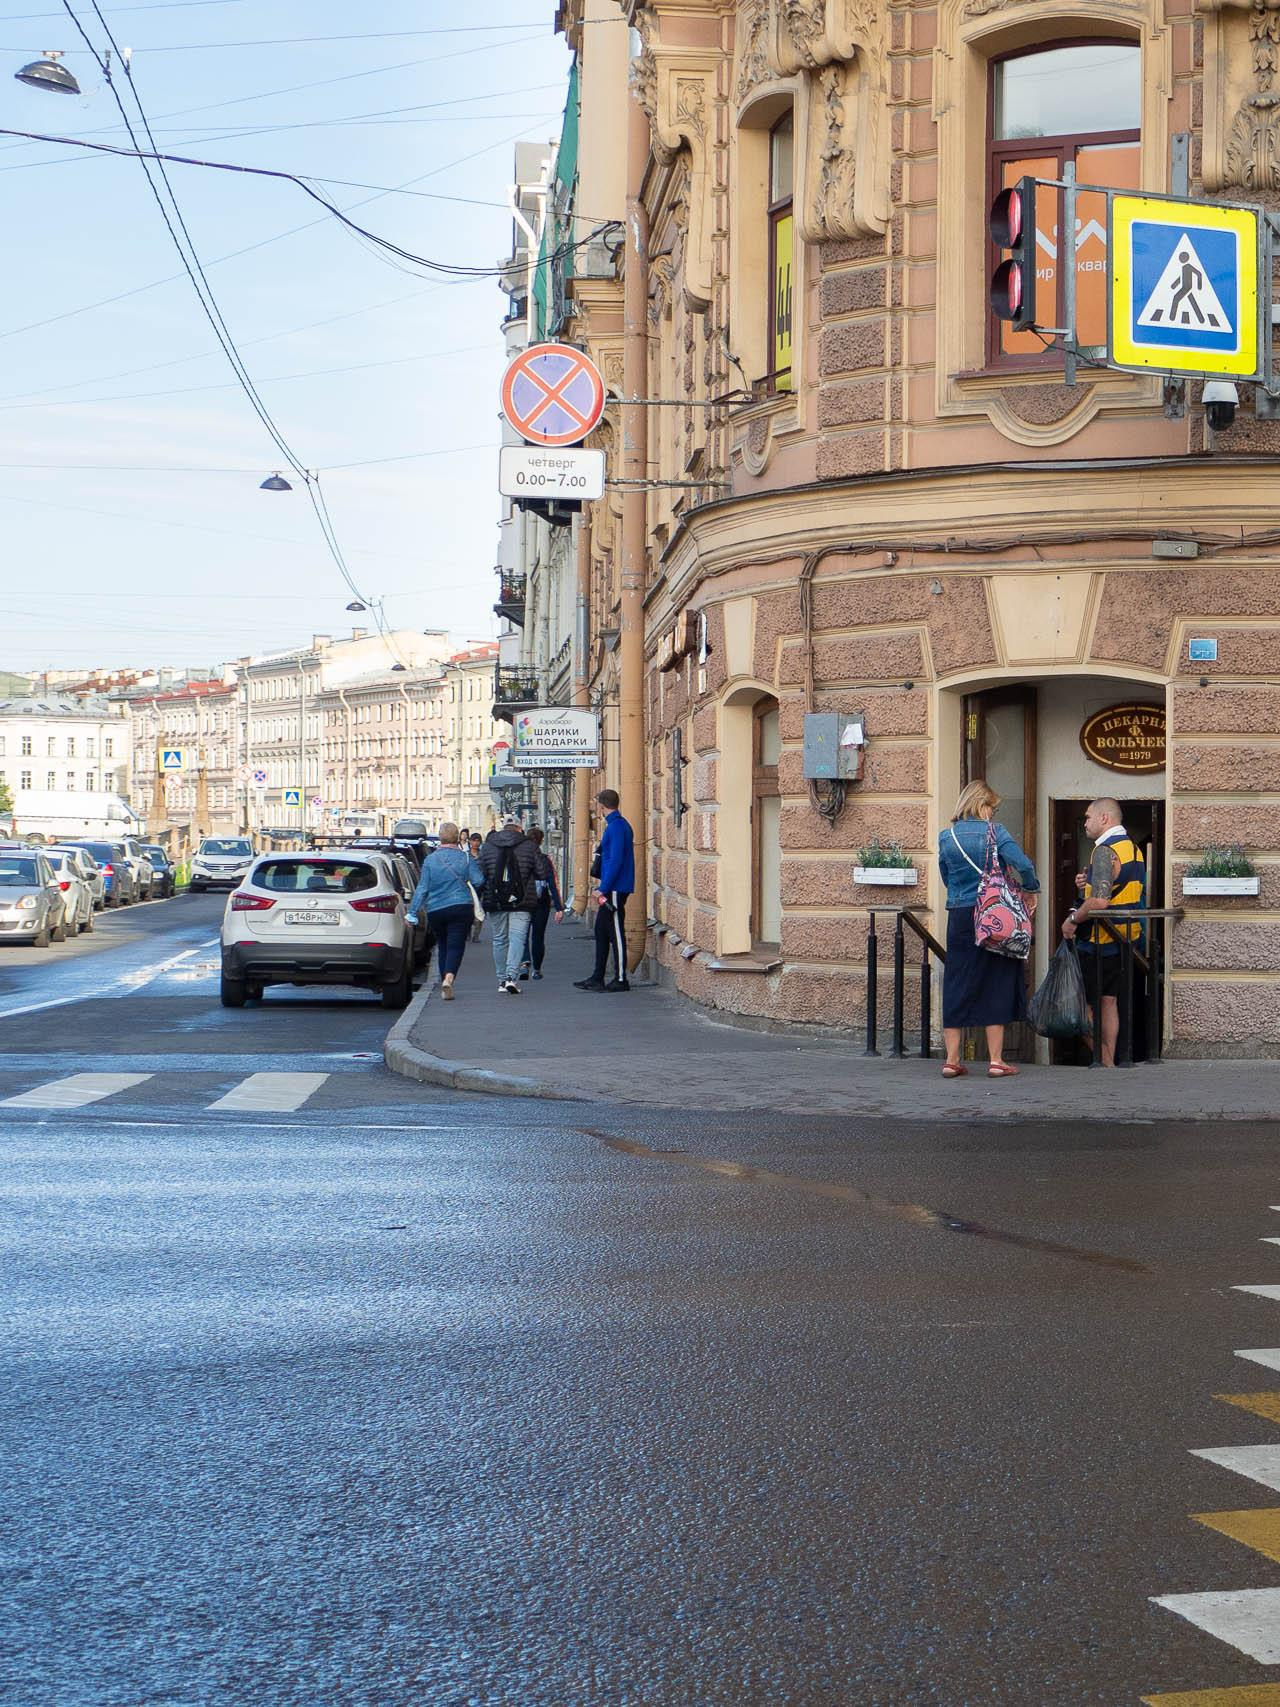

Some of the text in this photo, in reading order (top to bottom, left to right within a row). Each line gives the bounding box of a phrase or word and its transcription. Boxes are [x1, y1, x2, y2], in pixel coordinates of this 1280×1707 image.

[528, 458, 576, 470] четверг
[1102, 715, 1166, 732] ПЕКАРНЯ
[534, 728, 579, 736] ШАРИКИ
[526, 738, 587, 747] И ПОДАРКИ
[1129, 751, 1151, 760] 1979
